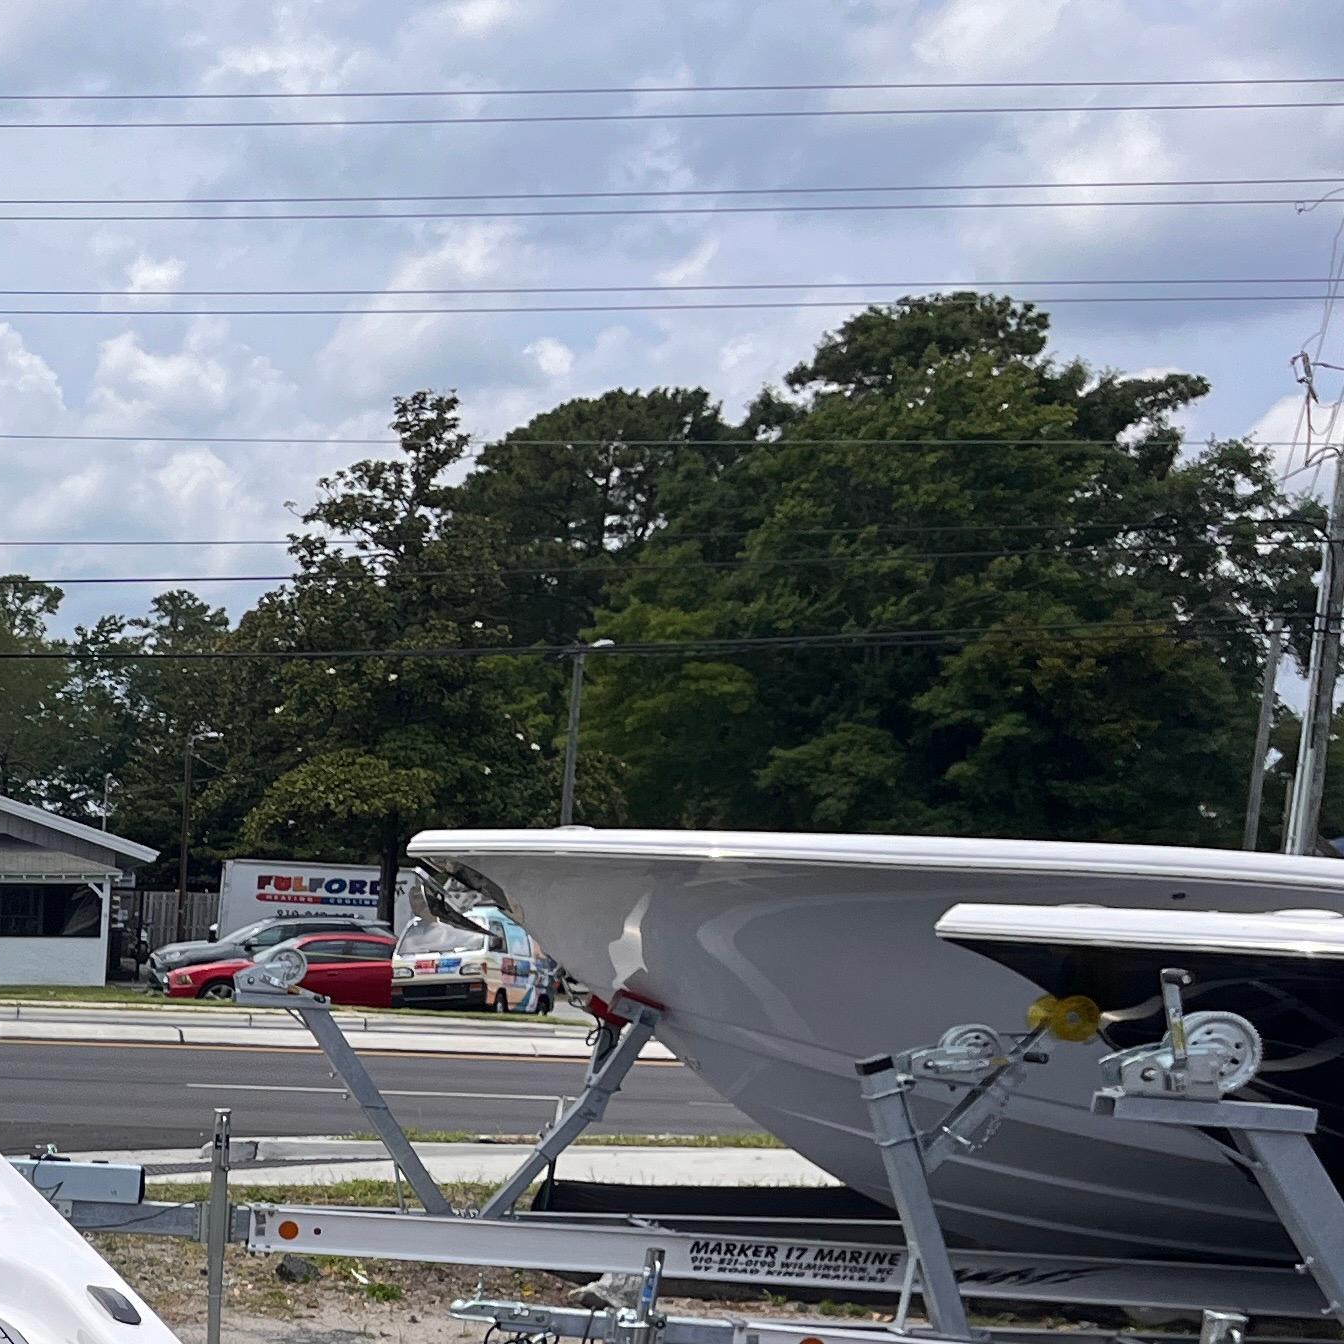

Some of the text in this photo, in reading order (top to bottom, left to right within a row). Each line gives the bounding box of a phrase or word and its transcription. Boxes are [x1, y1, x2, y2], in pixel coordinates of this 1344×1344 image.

[257, 875, 380, 896] FULFORD
[690, 1241, 902, 1267] MARKER 17 MARINE
